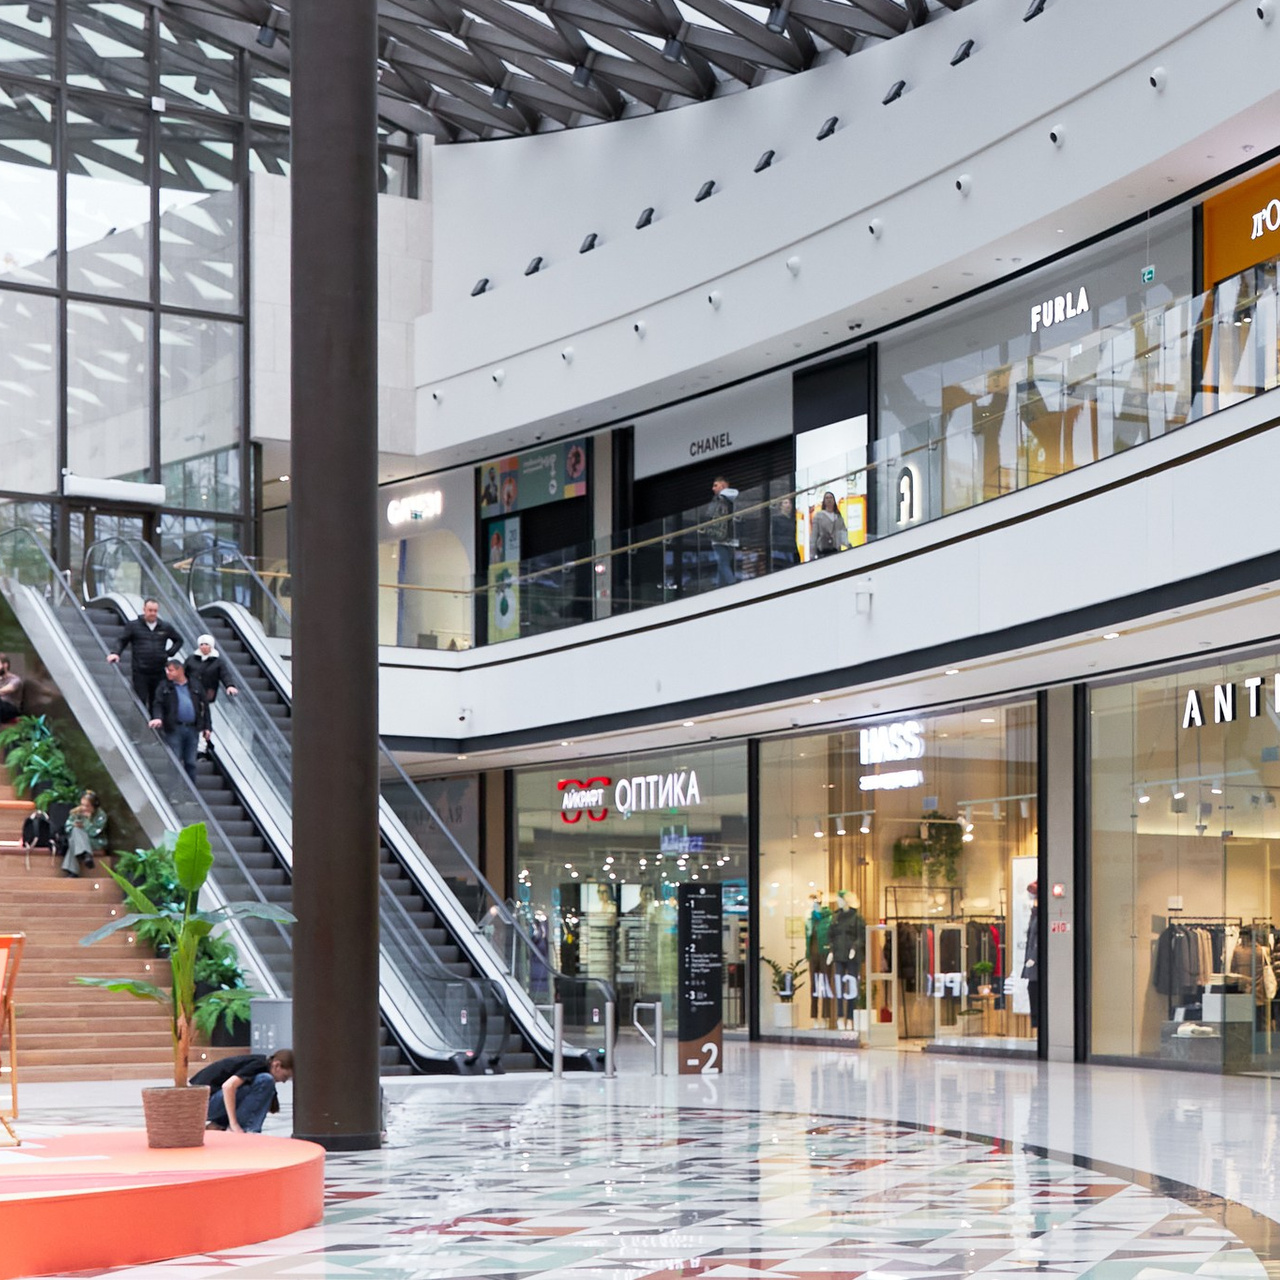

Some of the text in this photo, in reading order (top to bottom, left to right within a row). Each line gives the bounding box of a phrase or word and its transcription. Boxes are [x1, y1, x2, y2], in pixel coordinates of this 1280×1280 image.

[1031, 286, 1090, 333] FURLA
[690, 431, 732, 457] CHANEL
[614, 770, 701, 813] ОПТИКА
[686, 1042, 719, 1074] -2
